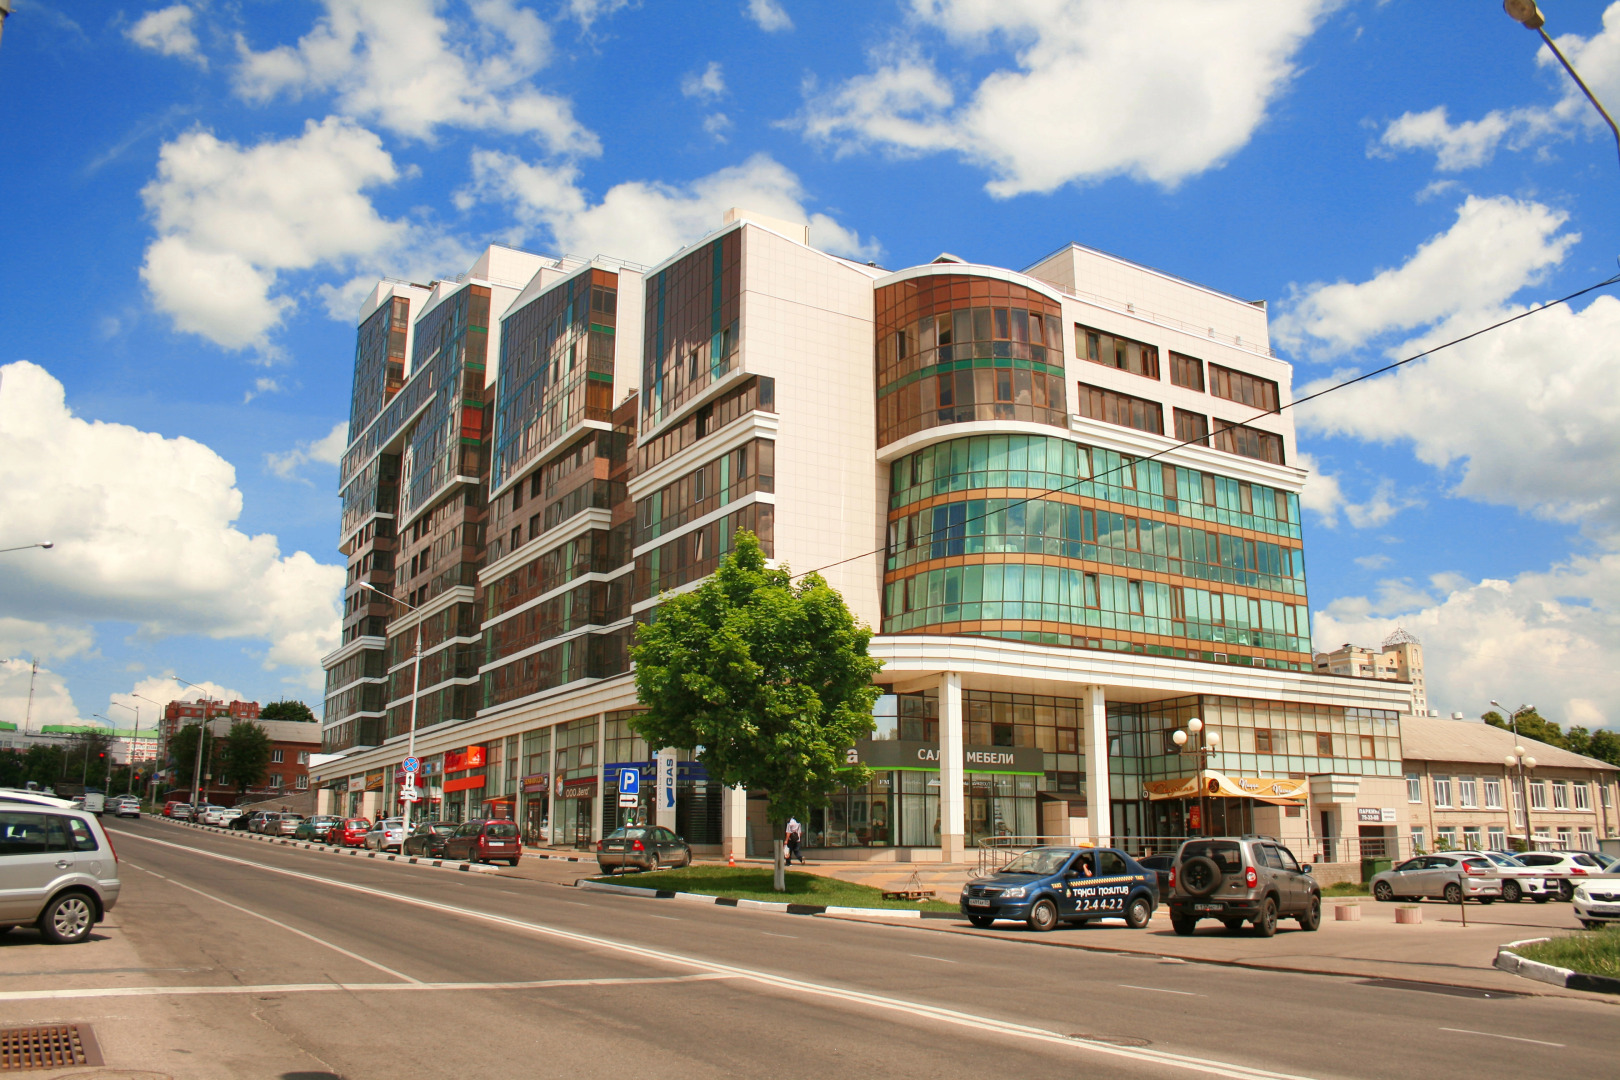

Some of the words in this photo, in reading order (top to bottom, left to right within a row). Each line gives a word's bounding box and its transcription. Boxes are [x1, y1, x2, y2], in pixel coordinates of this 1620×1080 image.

[917, 748, 941, 761] САЛ
[966, 751, 1014, 765] МЕБЕЛИ
[666, 758, 674, 787] GAS
